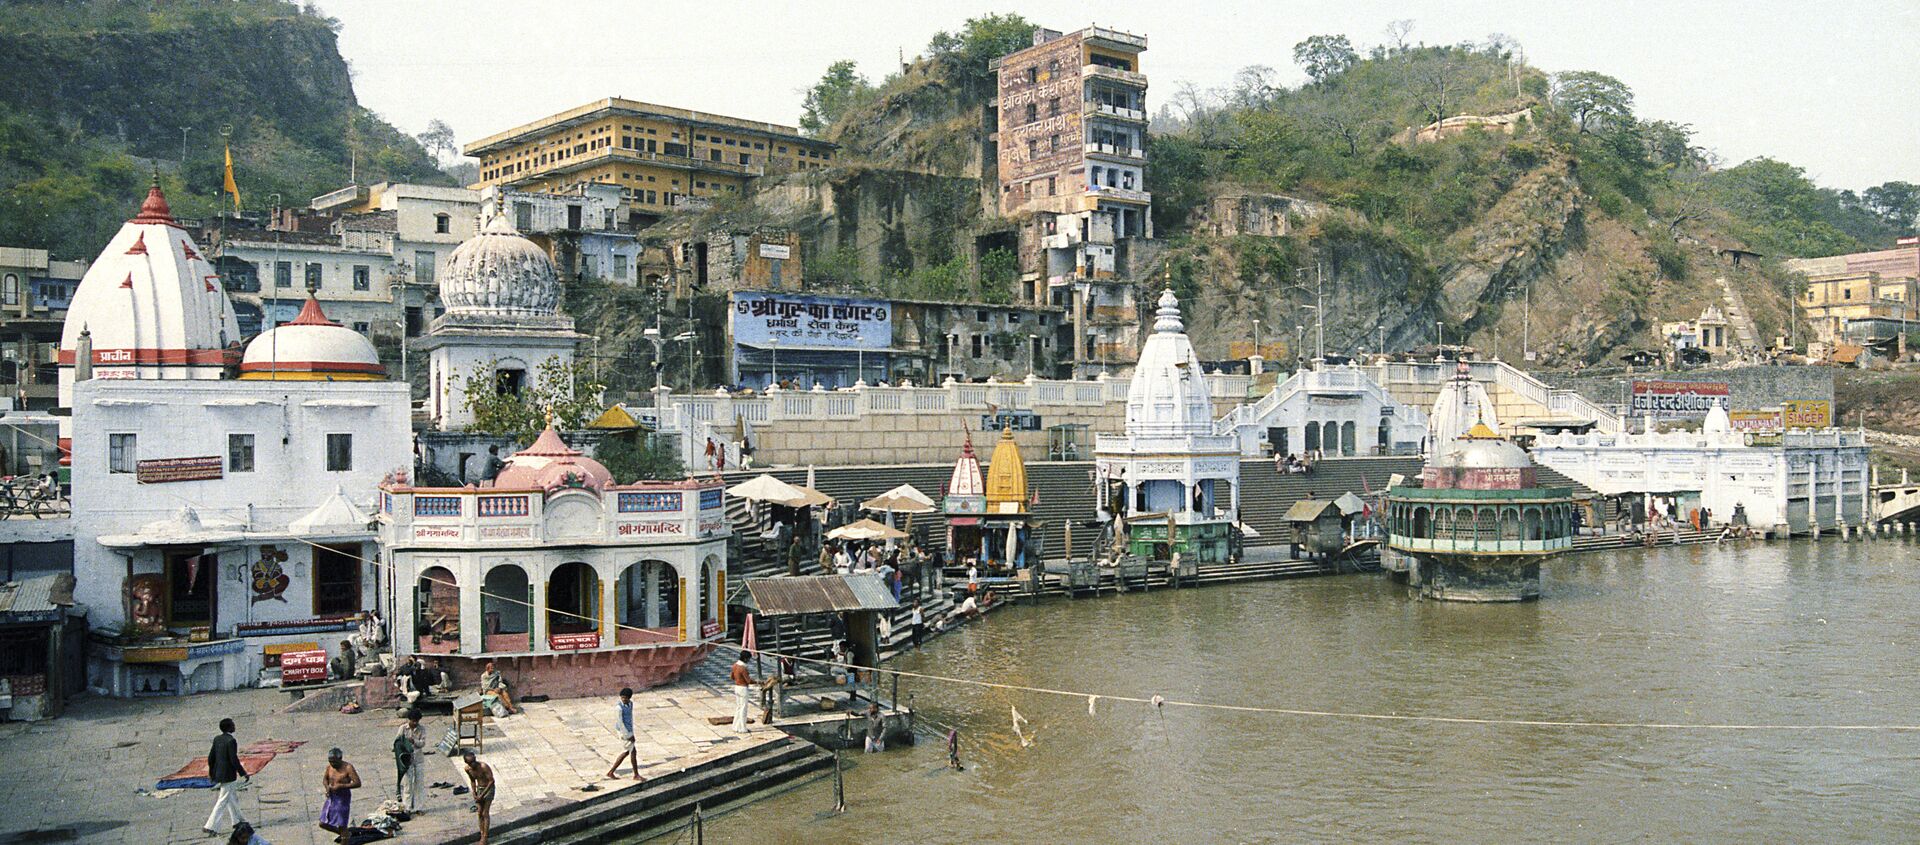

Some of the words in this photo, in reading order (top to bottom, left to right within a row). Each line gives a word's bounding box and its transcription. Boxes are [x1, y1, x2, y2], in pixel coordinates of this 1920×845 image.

[751, 298, 776, 317] श्री
[808, 303, 829, 320] का
[832, 301, 874, 321] लंगर
[766, 318, 798, 328] धर्मार्थ
[807, 319, 830, 330] सेवा
[100, 349, 131, 361] प्राचीन
[1788, 413, 1823, 424] SINGER
[416, 528, 426, 537] श्री
[618, 522, 632, 536] श्री
[283, 668, 310, 676] CHARITY
